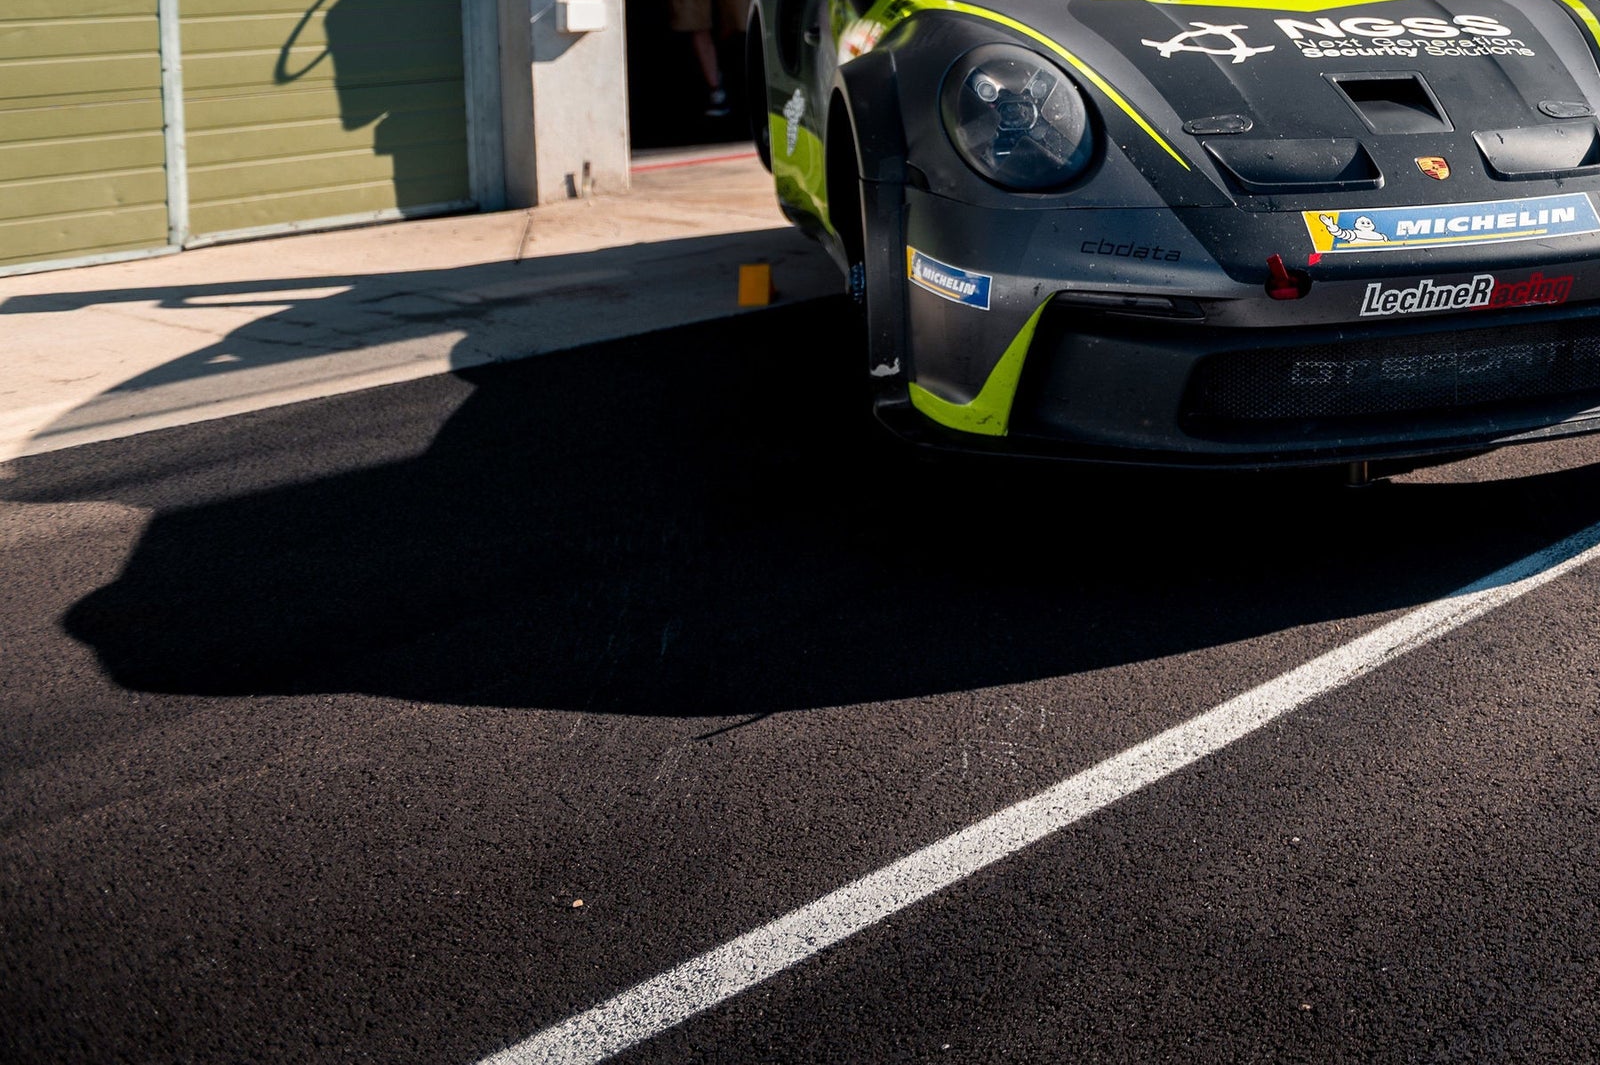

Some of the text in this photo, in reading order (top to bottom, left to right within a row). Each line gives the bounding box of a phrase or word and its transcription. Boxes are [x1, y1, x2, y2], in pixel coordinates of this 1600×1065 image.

[1273, 15, 1512, 40] NGSS
[1293, 36, 1525, 48] Next Generation
[1302, 45, 1535, 59] Security Solutions
[1396, 207, 1576, 236] MICHELIN
[1080, 239, 1182, 262] cbdata
[922, 267, 976, 296] MICHELIN
